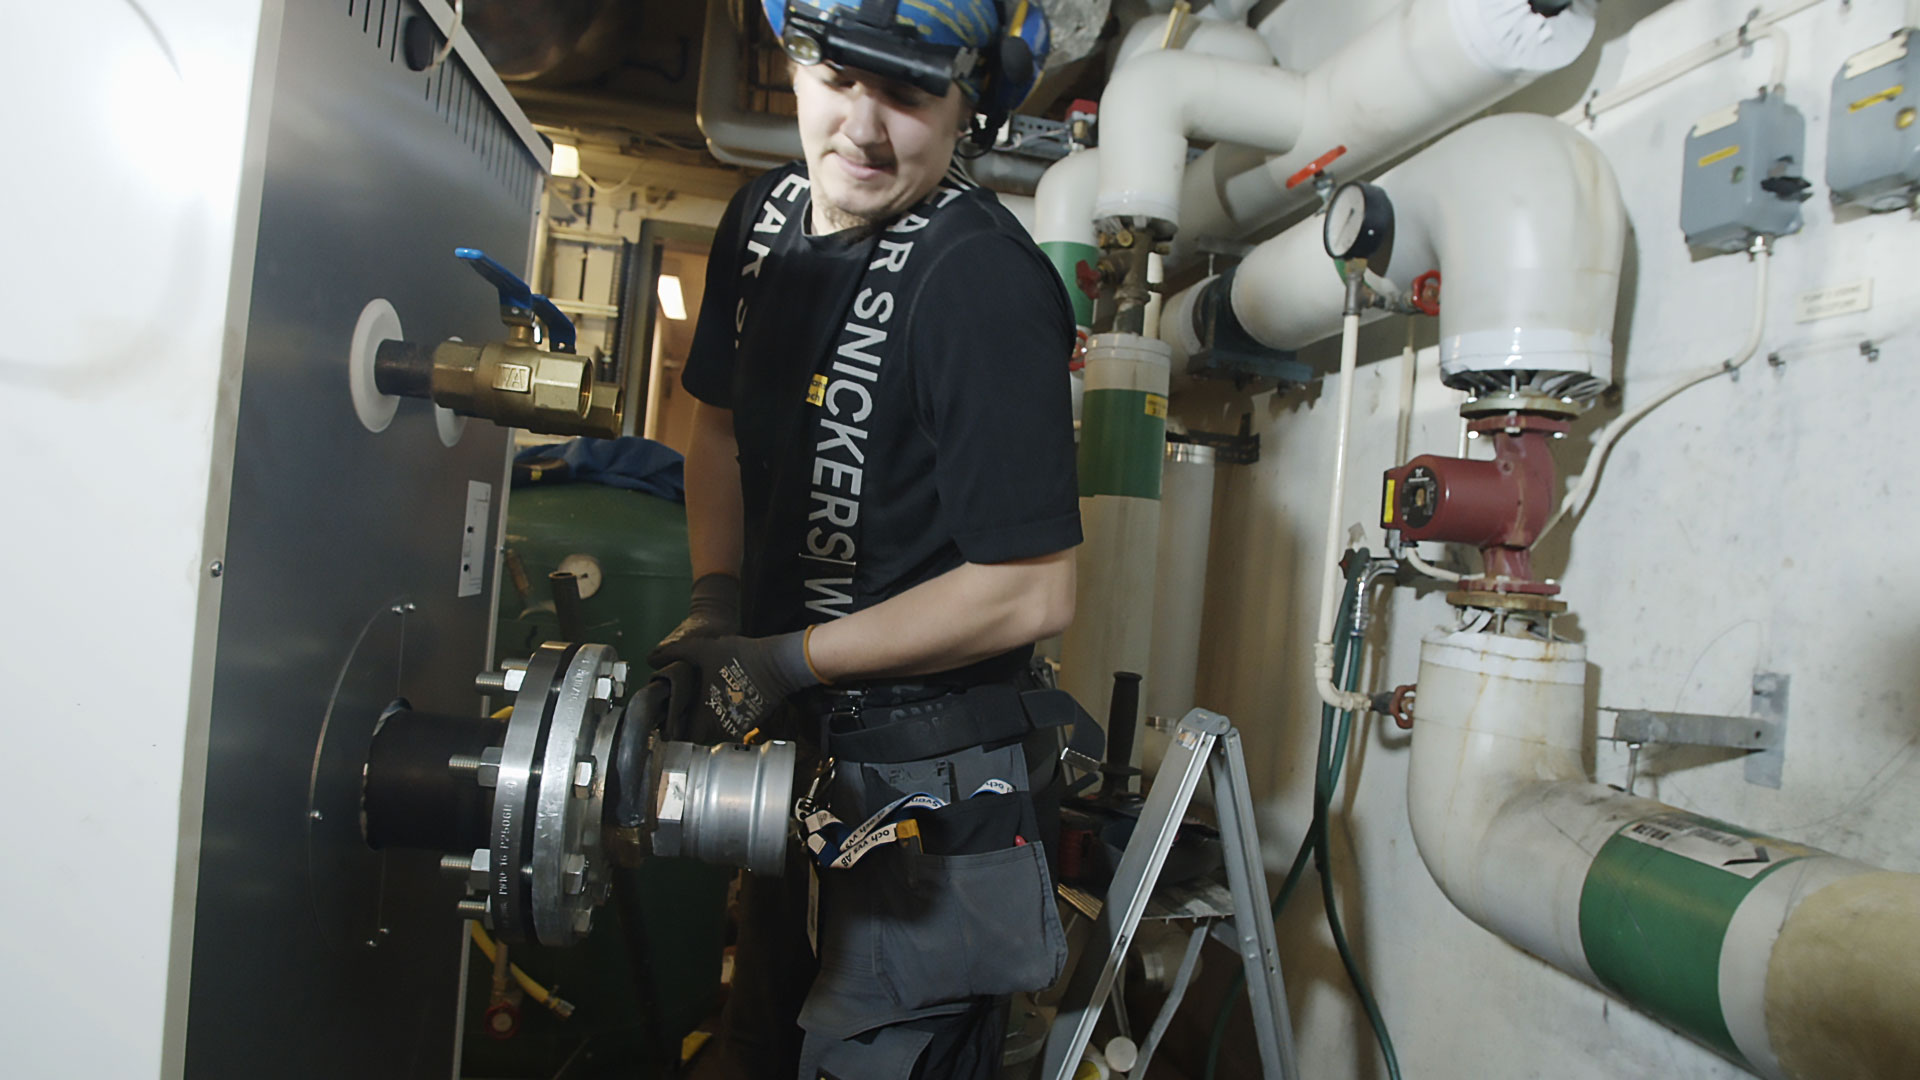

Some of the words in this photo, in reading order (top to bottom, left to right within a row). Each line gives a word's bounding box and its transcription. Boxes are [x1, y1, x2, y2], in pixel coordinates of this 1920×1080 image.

[806, 287, 895, 561] SNICKERS
[859, 819, 876, 833] och
[845, 834, 859, 849] vvs
[870, 829, 890, 842] och
[853, 840, 868, 854] vvs
[841, 852, 853, 867] AB
